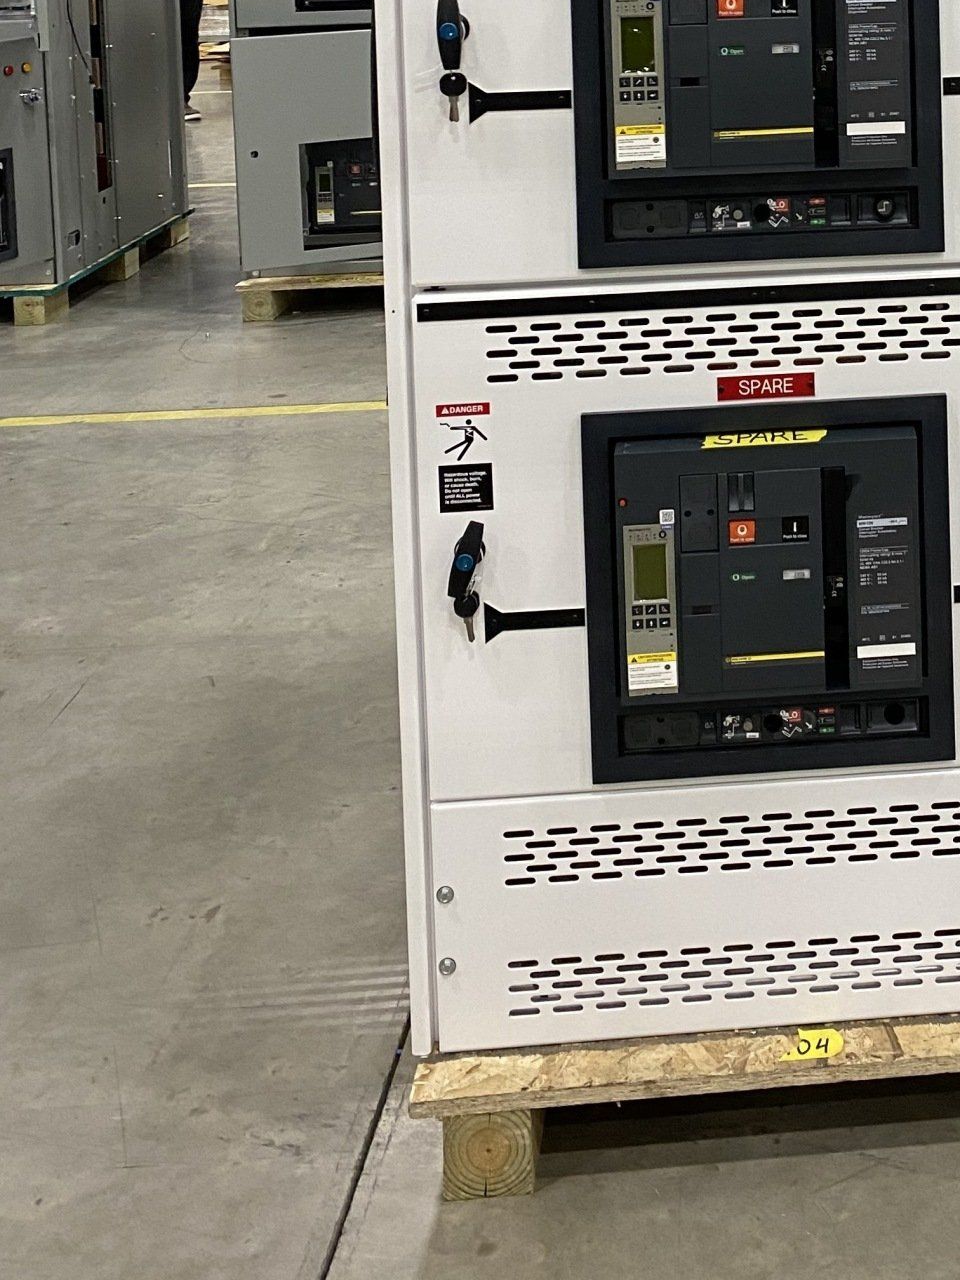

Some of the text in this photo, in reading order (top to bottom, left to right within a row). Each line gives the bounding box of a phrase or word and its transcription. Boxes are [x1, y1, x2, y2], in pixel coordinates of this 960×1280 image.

[738, 377, 794, 396] SPARE
[449, 405, 484, 414] DANGER
[713, 428, 808, 445] SPARE
[786, 1037, 830, 1056] 04
